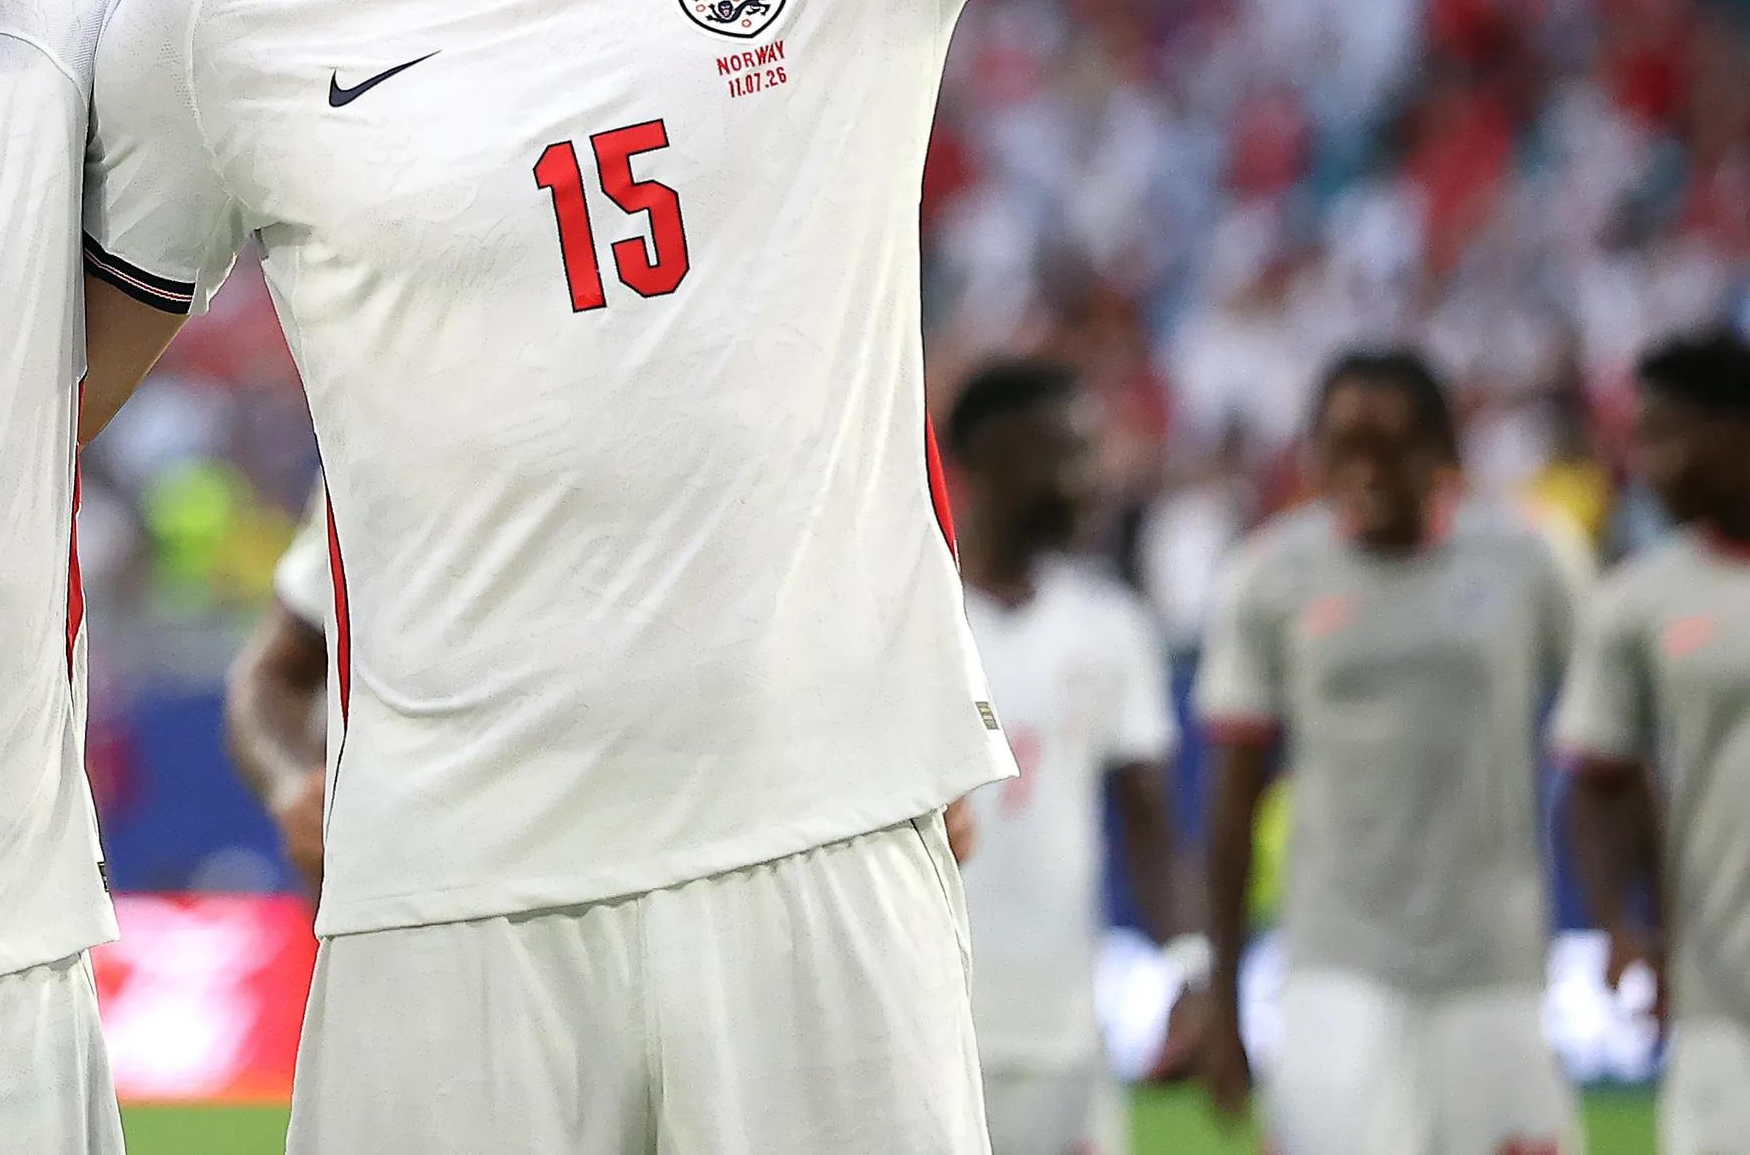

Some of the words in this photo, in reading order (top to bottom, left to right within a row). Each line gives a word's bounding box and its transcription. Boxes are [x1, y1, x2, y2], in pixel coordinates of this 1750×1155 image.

[716, 40, 785, 76] NORWAY
[728, 66, 787, 98] 11.07.26
[532, 118, 690, 313] 15
